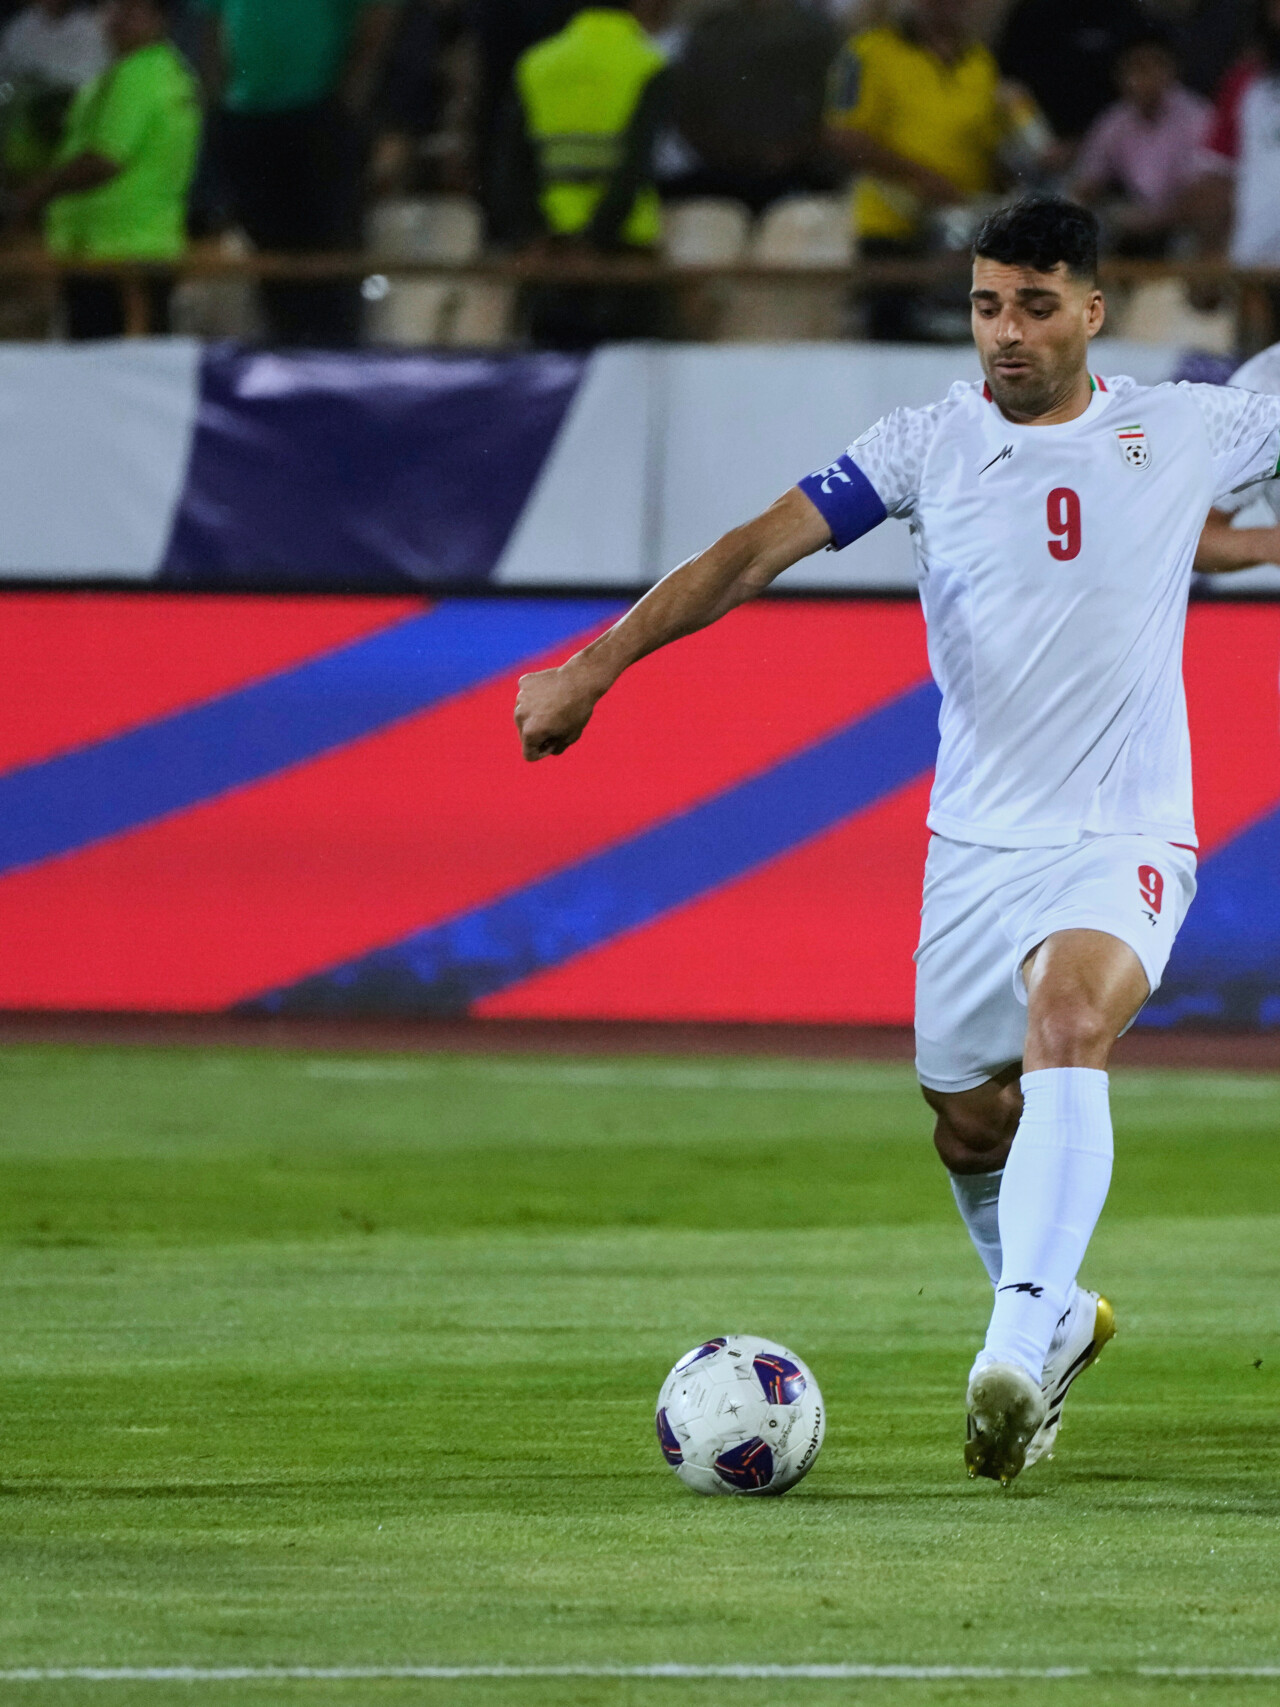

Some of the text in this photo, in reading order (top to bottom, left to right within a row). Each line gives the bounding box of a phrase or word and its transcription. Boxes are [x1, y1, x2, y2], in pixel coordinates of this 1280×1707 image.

[1046, 487, 1082, 561] 9
[1137, 864, 1164, 914] 9
[796, 1406, 821, 1470] molten
